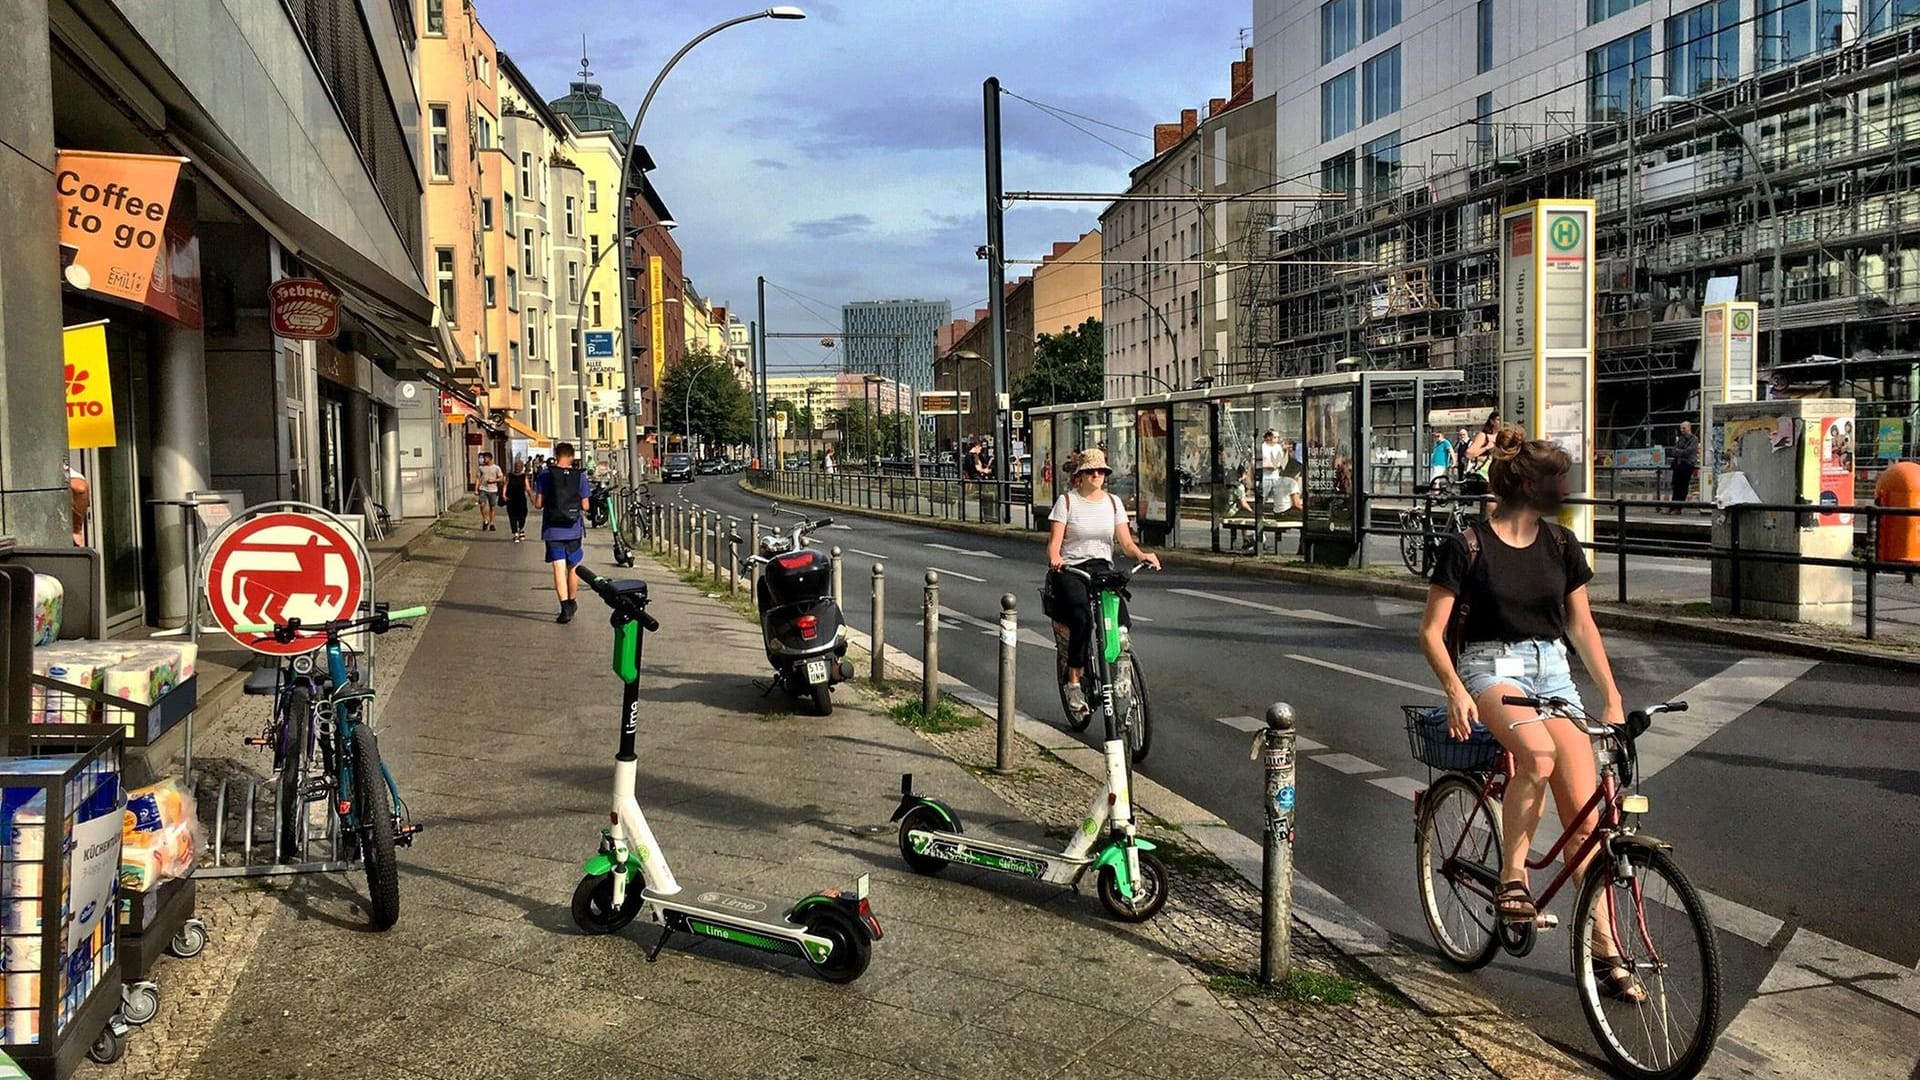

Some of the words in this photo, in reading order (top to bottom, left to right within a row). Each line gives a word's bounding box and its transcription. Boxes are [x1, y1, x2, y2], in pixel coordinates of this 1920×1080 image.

[56, 170, 164, 221] Coffee
[68, 206, 102, 233] to
[114, 224, 157, 249] go
[1558, 223, 1572, 244] H
[1516, 268, 1526, 315] Berlin.
[1516, 319, 1525, 346] Und
[588, 346, 596, 354] P
[66, 401, 103, 418] TTO
[1516, 394, 1525, 416] für
[809, 662, 824, 672] 515
[1102, 684, 1114, 717] Lime
[626, 701, 639, 734] Lime
[721, 898, 756, 911] Lime
[706, 925, 729, 939] Lime
